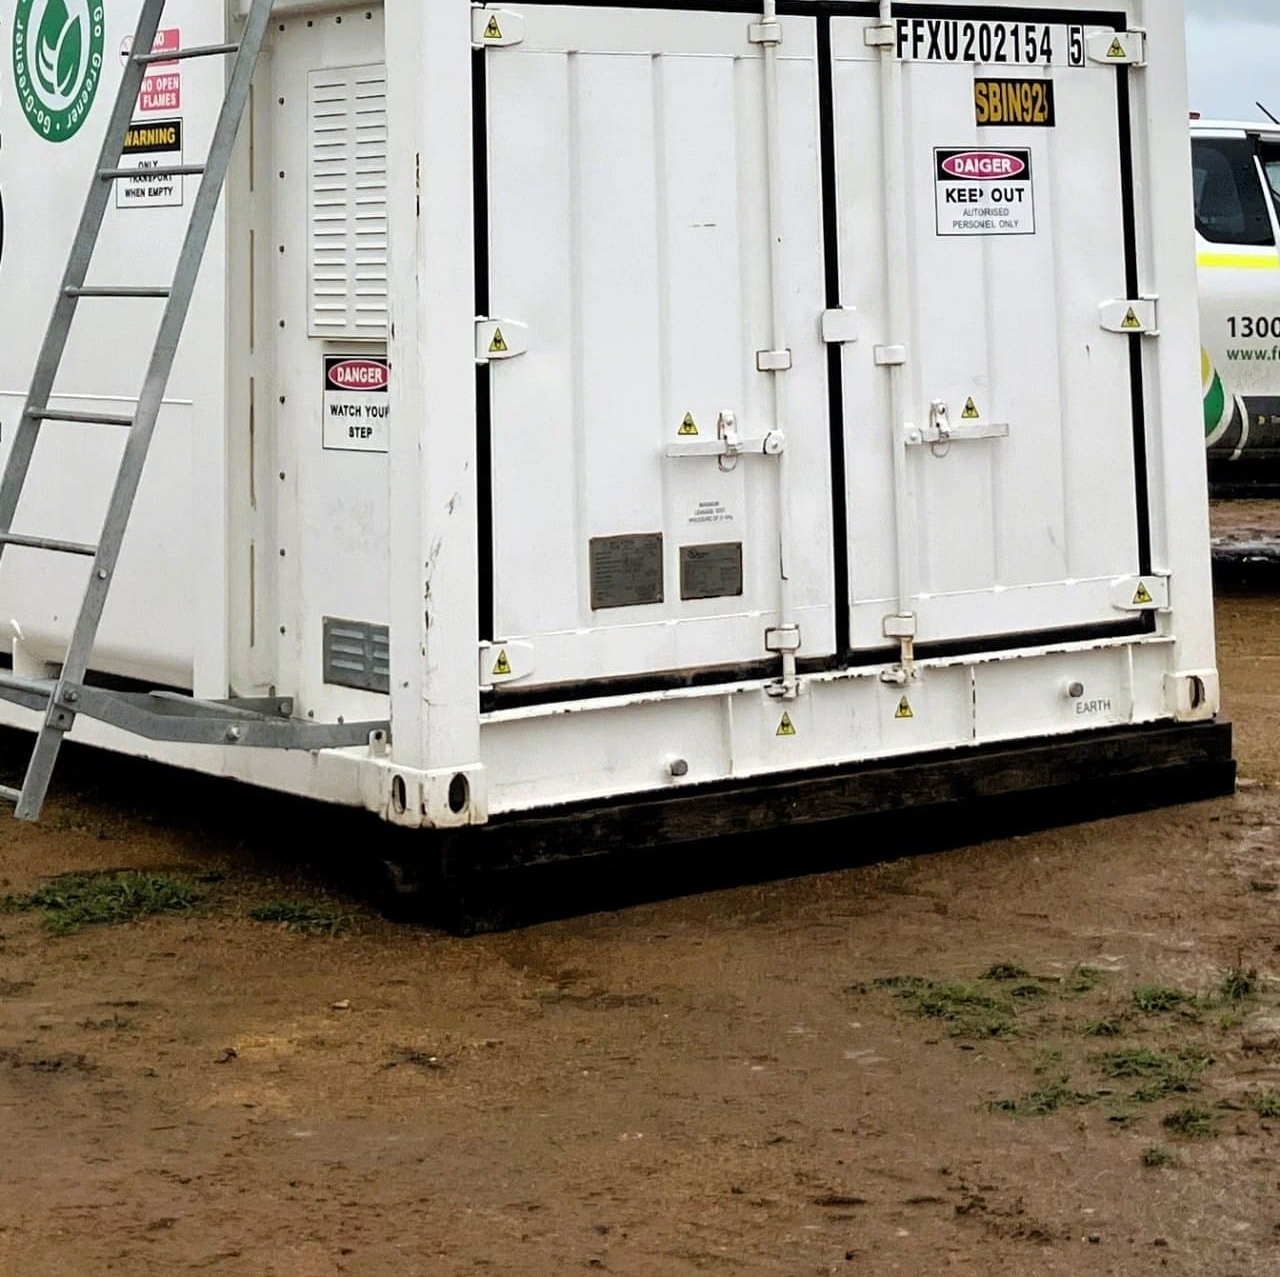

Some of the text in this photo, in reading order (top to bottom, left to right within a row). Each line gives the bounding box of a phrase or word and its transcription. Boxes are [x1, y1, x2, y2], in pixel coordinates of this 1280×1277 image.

[1070, 25, 1083, 65] 5
[141, 77, 179, 92] NO OPEN
[143, 93, 177, 108] FLAMES
[125, 186, 173, 197] WHEN EMPTY
[991, 188, 1024, 203] OUT
[999, 219, 1019, 228] ONLY
[337, 366, 383, 383] DANGER
[330, 404, 362, 417] WATCH
[348, 426, 373, 438] STEP
[1076, 699, 1111, 714] EARTH
